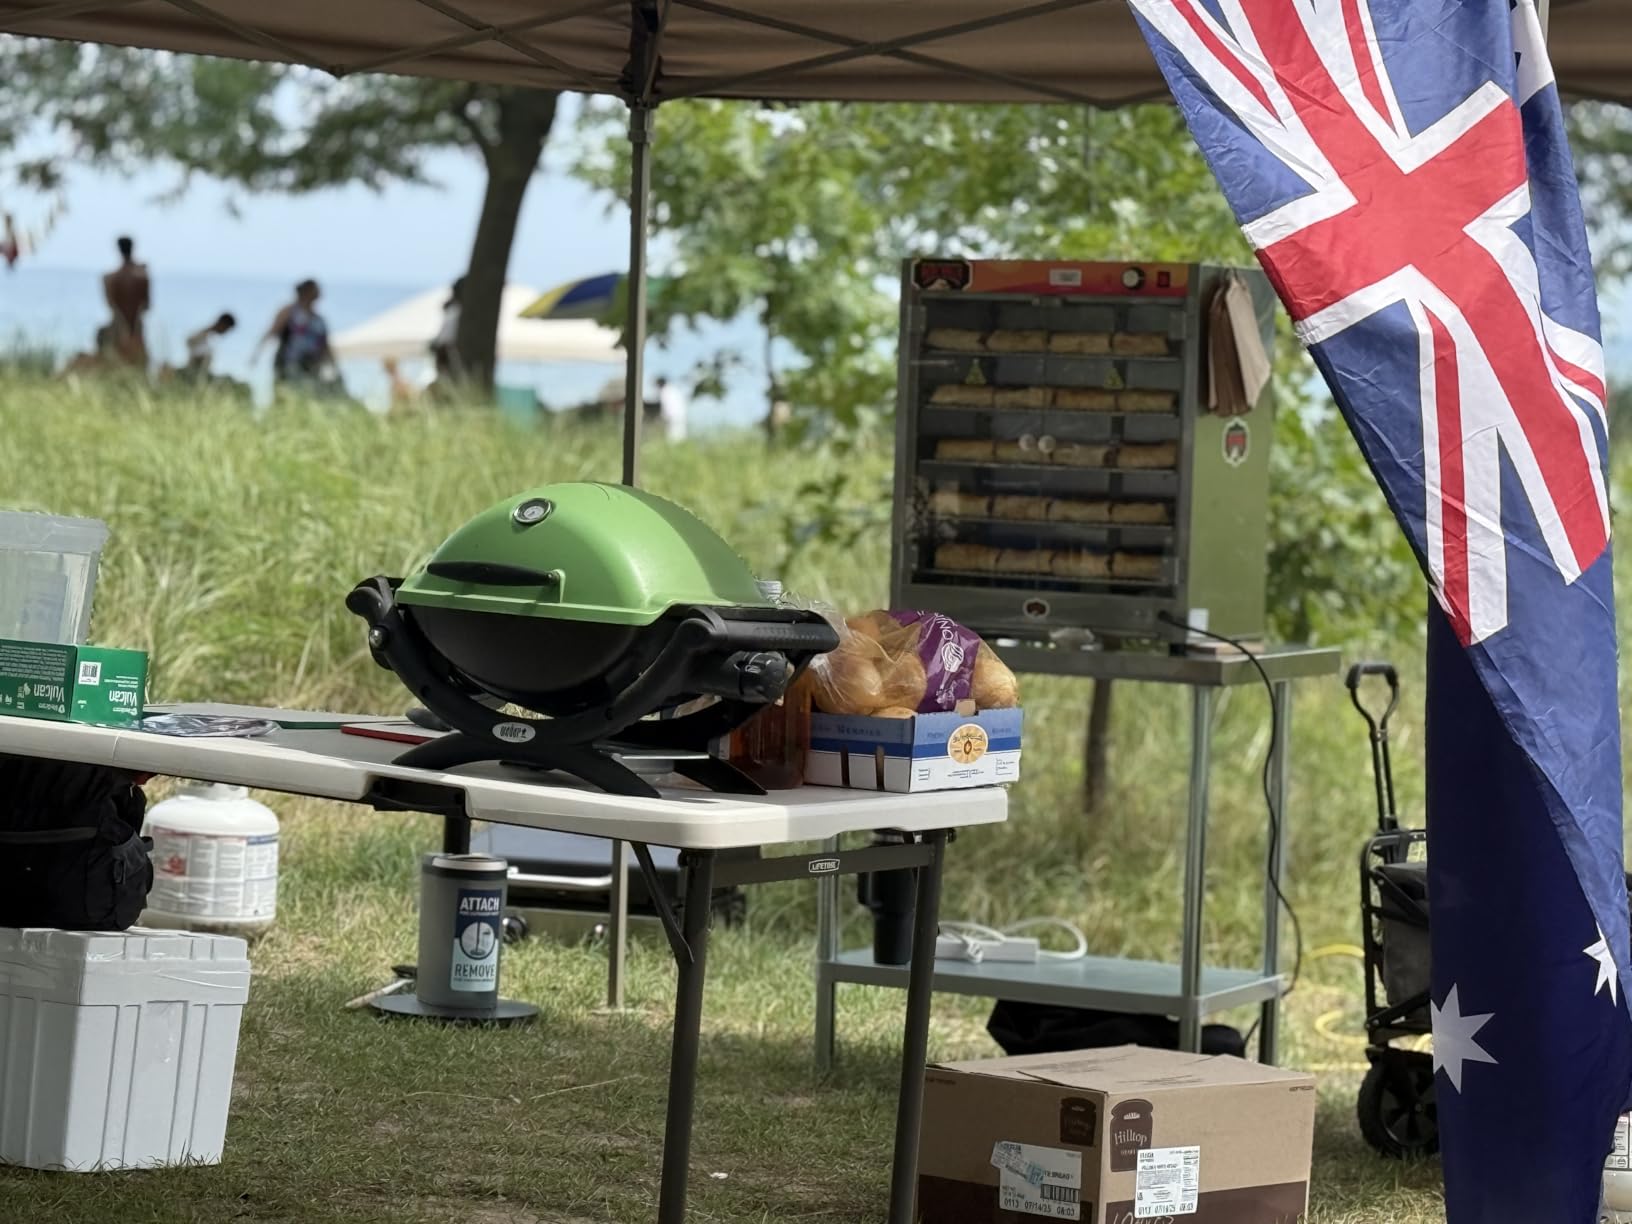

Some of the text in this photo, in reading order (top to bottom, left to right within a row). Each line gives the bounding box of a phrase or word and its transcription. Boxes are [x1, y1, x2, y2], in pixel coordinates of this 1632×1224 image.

[34, 684, 65, 702] Vulcan
[109, 690, 138, 706] Vulcan
[459, 896, 500, 911] ATTACH
[454, 963, 495, 978] REMOVE
[1114, 1128, 1148, 1147] Hilltop
